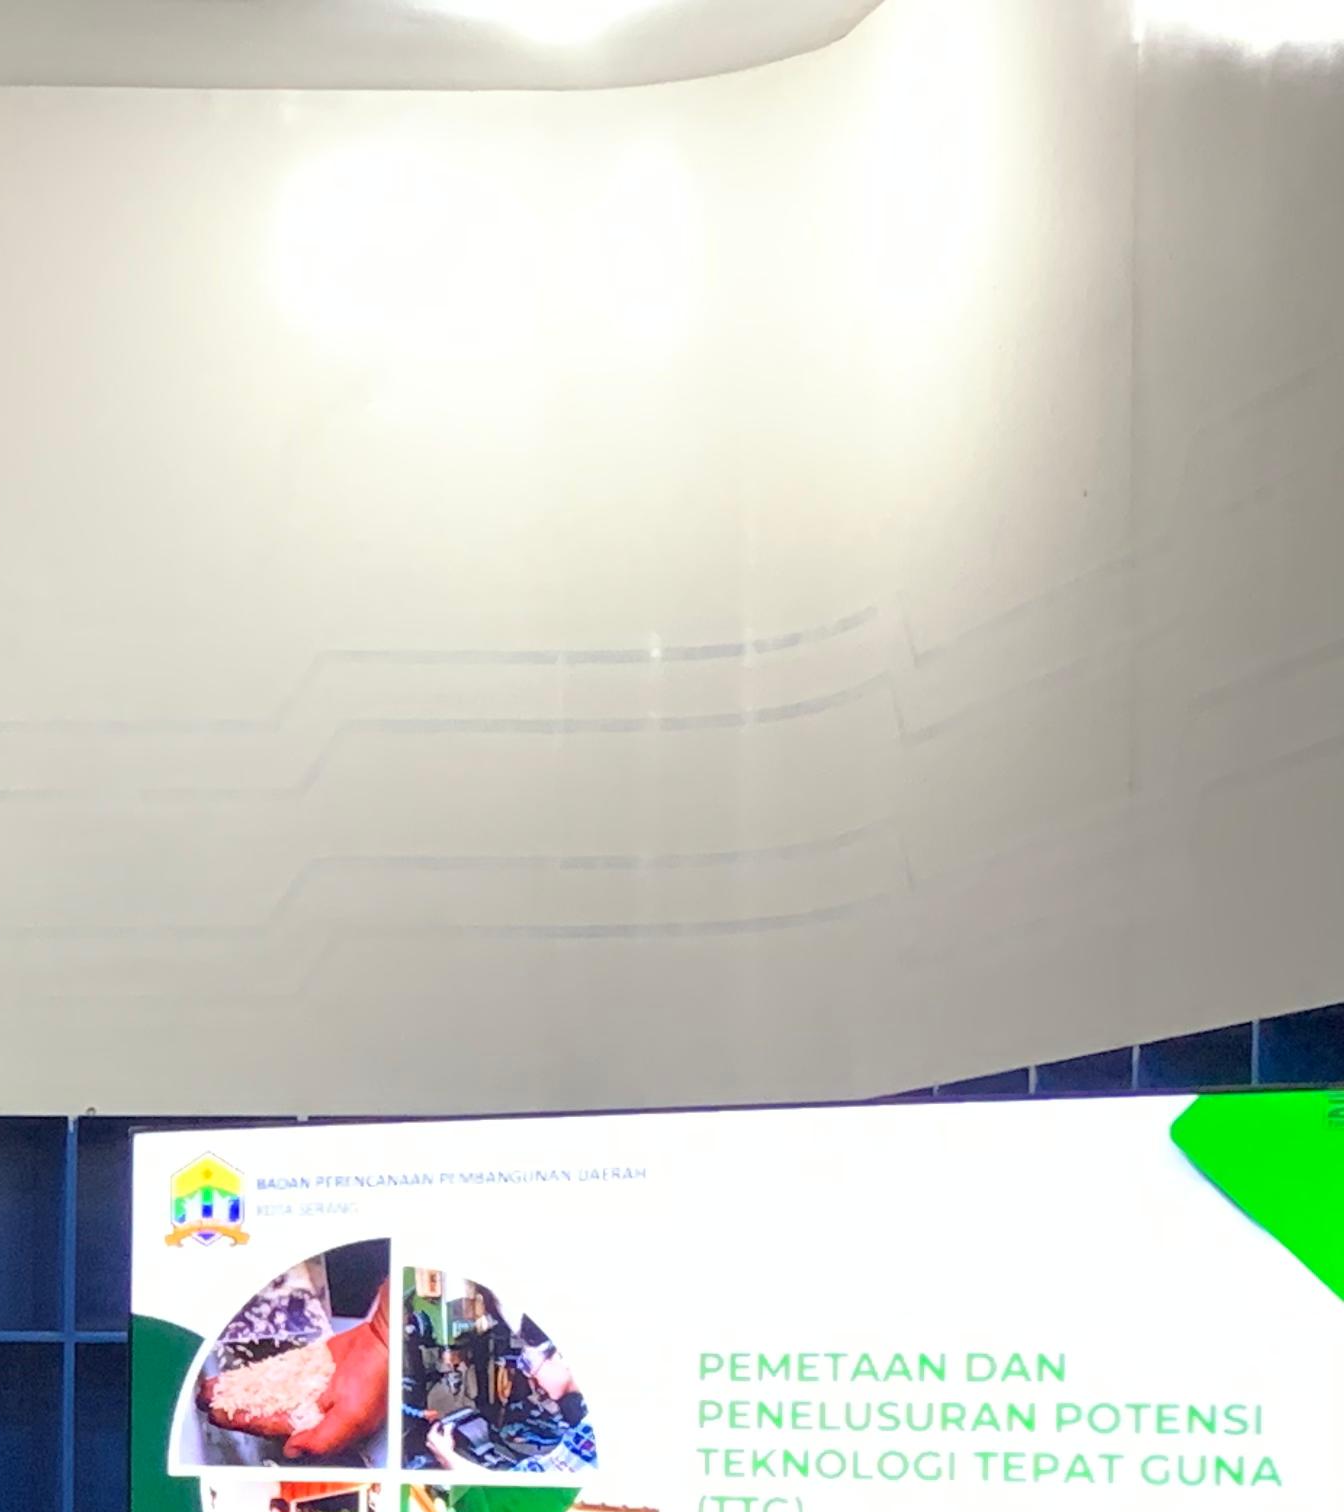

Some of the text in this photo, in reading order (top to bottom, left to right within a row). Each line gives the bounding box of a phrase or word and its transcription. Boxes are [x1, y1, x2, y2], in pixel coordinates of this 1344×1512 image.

[256, 1176, 310, 1190] BADAN
[698, 1351, 1067, 1383] PEMETAAN DAN
[697, 1400, 1263, 1435] PENELUSURAN POTENSI
[696, 1448, 1284, 1487] TEKNOLOGI TEPAT GUNA
